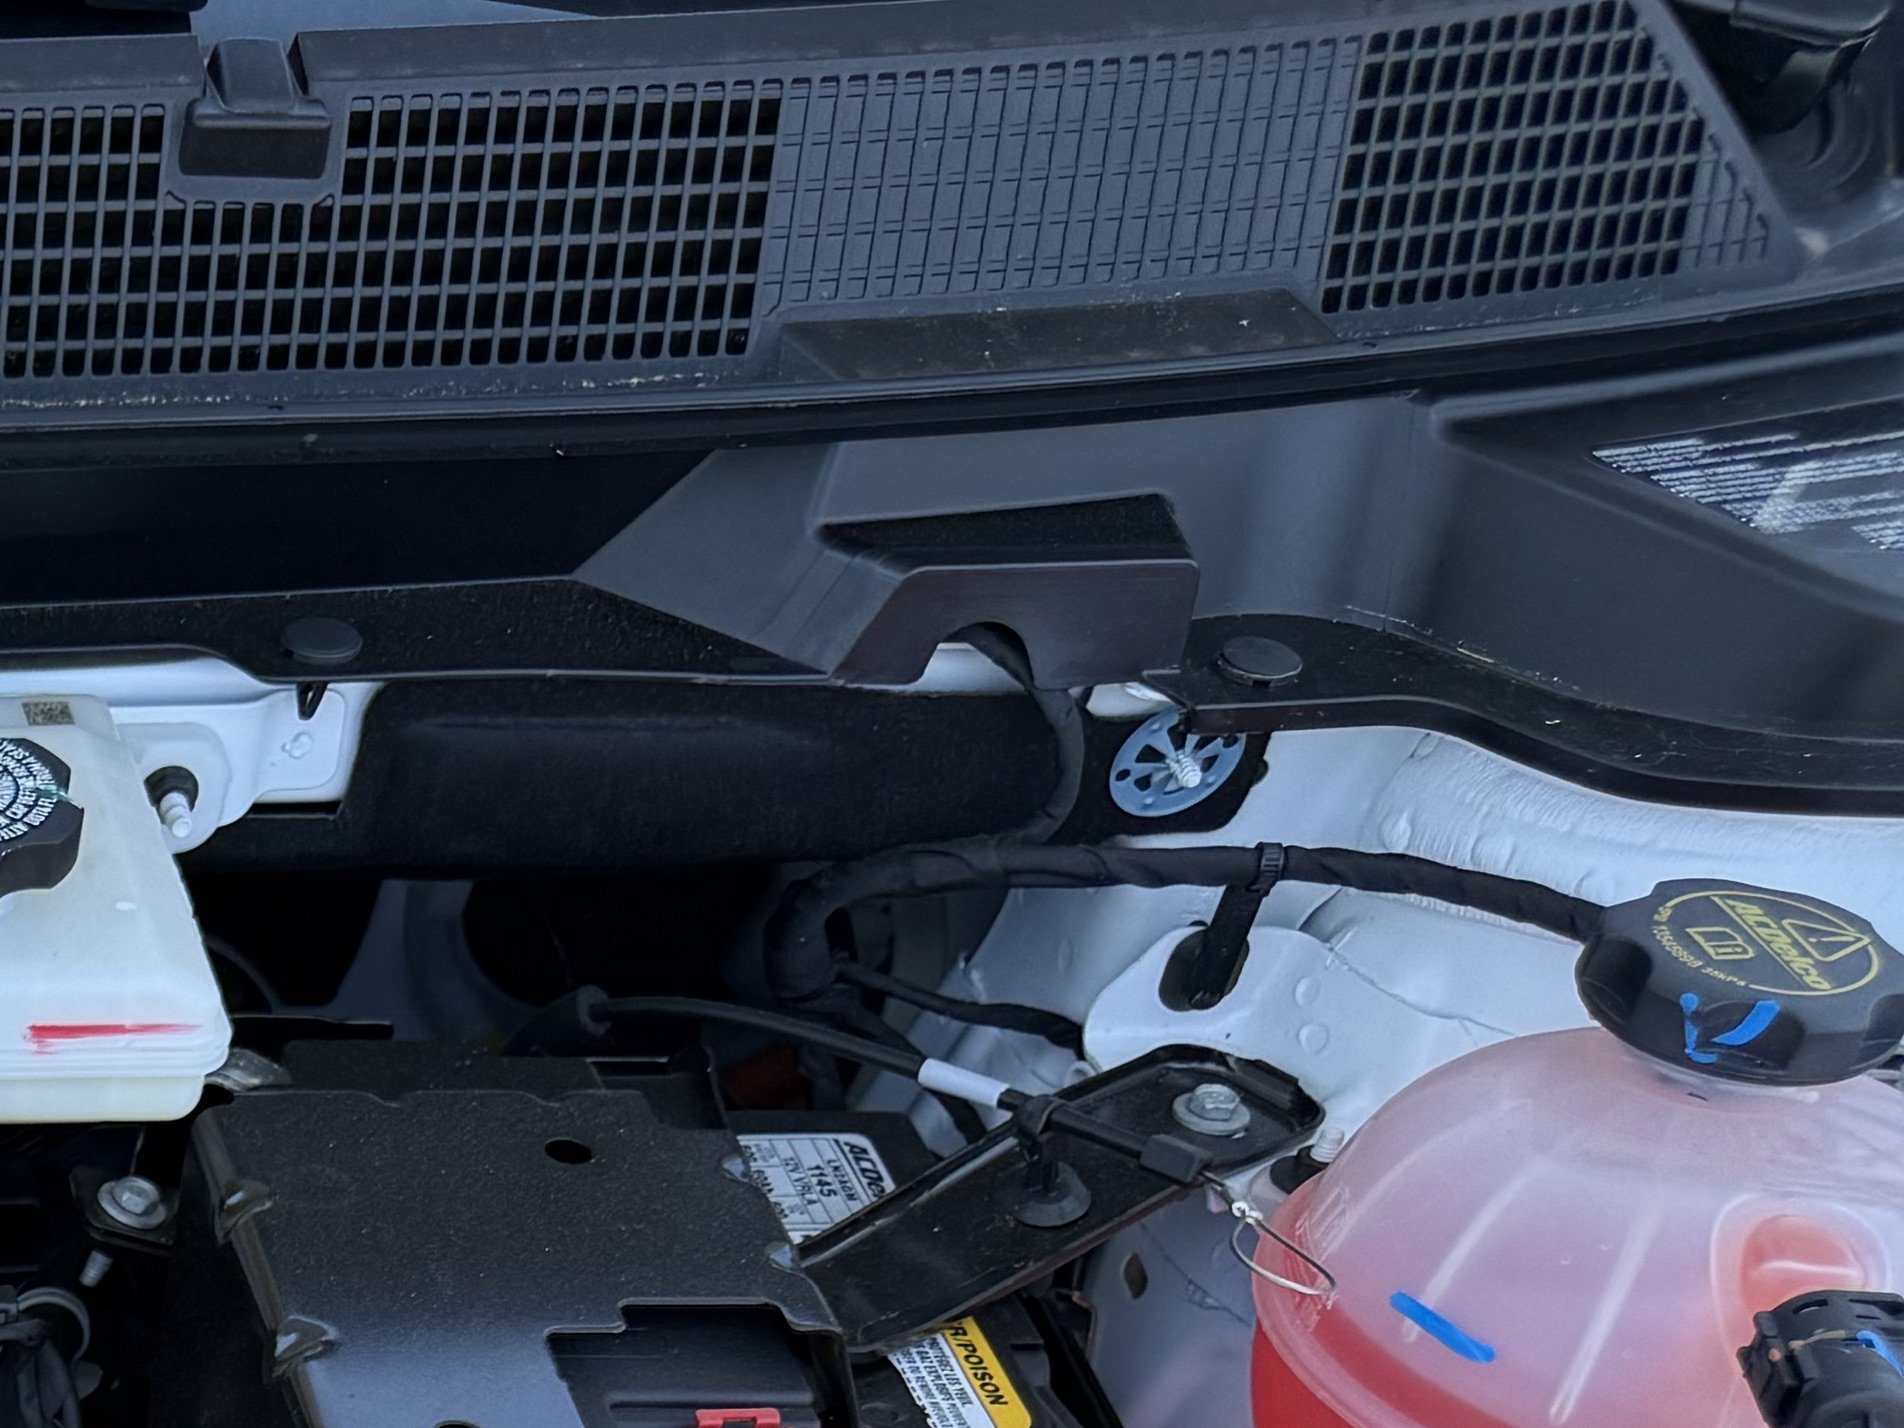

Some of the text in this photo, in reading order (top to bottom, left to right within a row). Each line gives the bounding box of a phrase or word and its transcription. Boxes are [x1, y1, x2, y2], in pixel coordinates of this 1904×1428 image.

[1724, 899, 1833, 991] ACDelco
[807, 1164, 839, 1199] 1145
[844, 1141, 887, 1199] ACDe
[950, 1321, 1009, 1406] R/POISON
